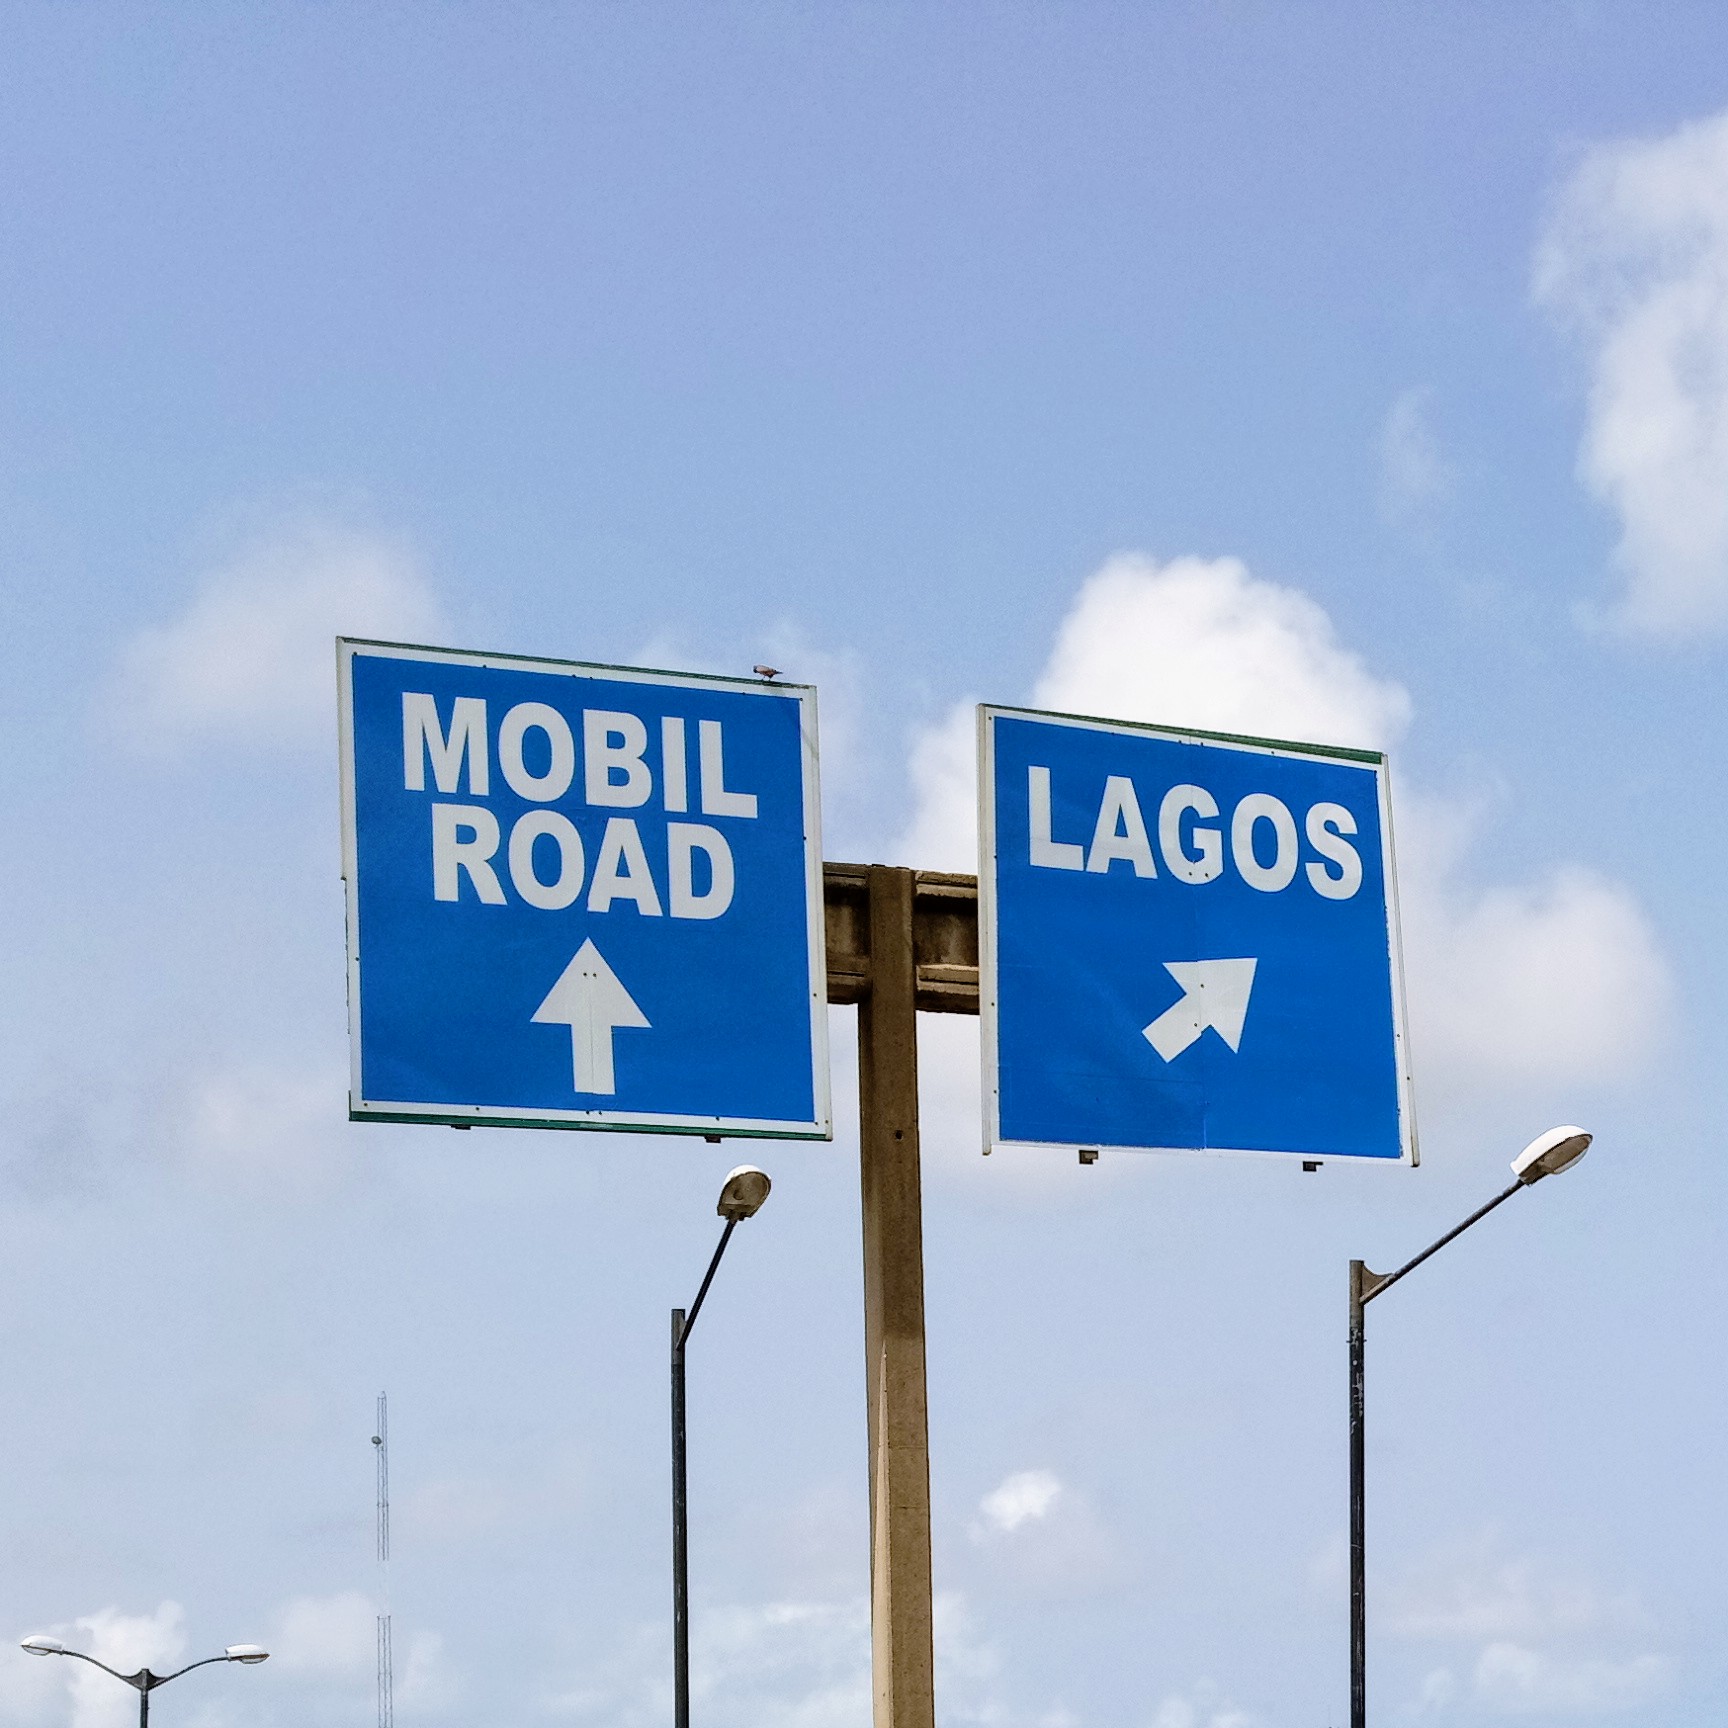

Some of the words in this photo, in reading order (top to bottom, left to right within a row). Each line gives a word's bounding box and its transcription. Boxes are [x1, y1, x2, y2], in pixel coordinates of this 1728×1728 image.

[403, 692, 758, 819] MOBIL
[432, 803, 735, 920] ROAD
[1028, 766, 1363, 900] LAGOS
